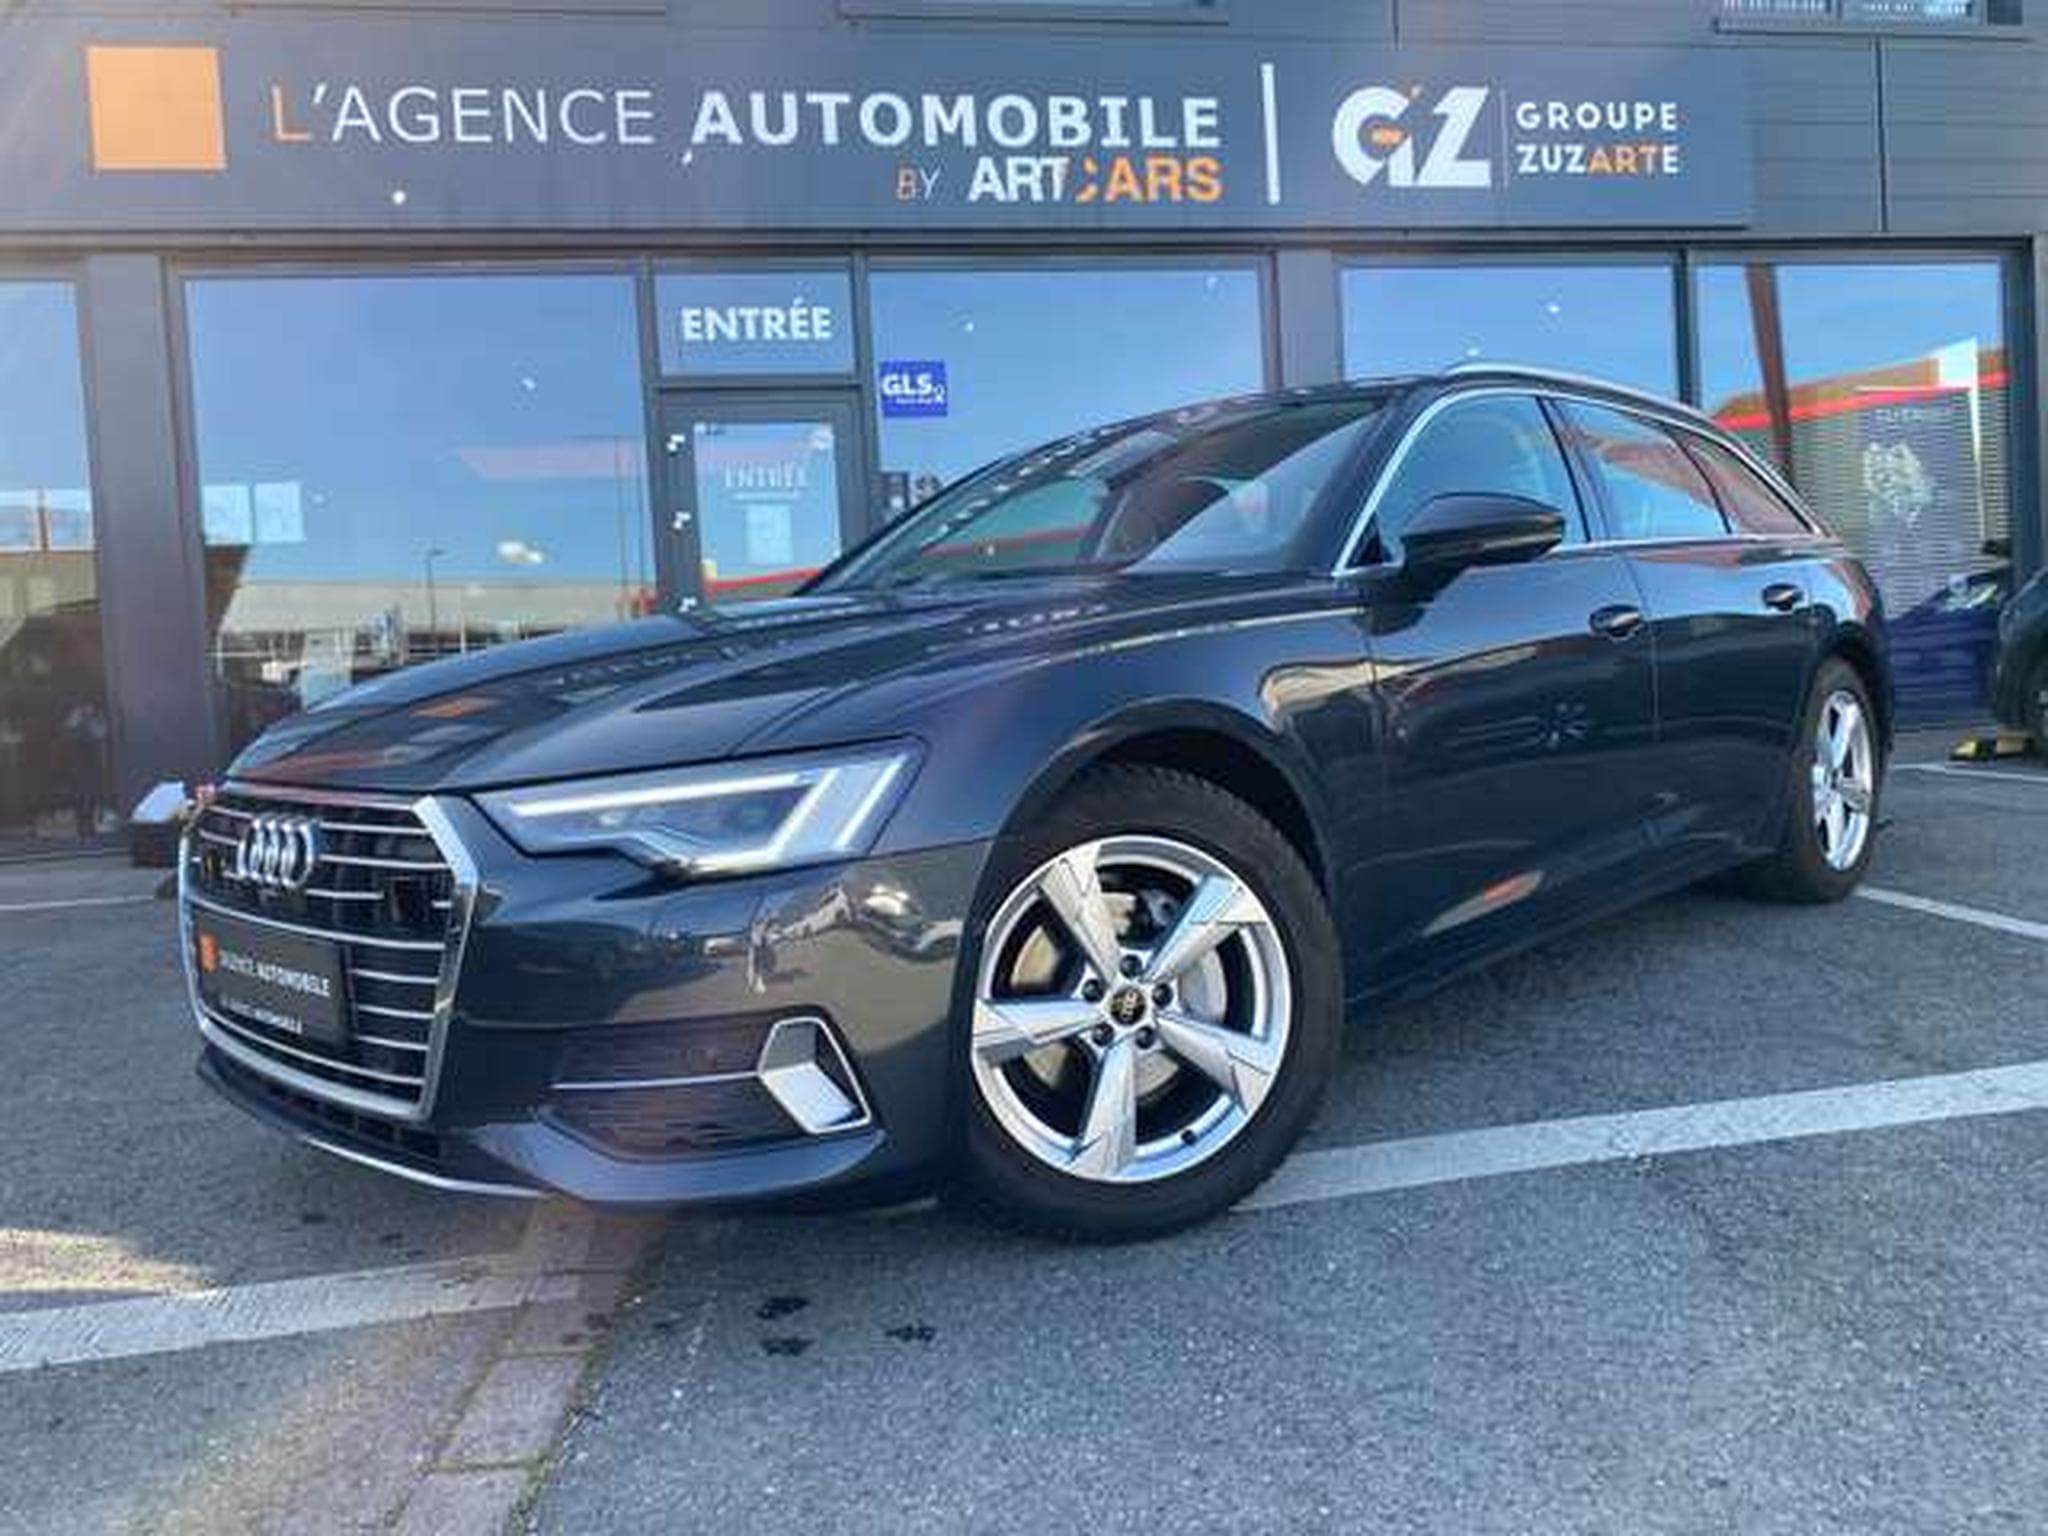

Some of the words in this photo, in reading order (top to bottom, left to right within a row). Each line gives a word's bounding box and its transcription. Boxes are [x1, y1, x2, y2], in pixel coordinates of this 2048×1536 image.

[272, 84, 655, 145] L'AGENCE
[690, 91, 1221, 148] AUTOMOBILE
[1515, 101, 1678, 131] GROUPE
[1516, 143, 1680, 174] ZUZARTE
[897, 165, 941, 200] BY
[682, 296, 832, 341] ENTRÉE
[882, 373, 932, 397] GLS
